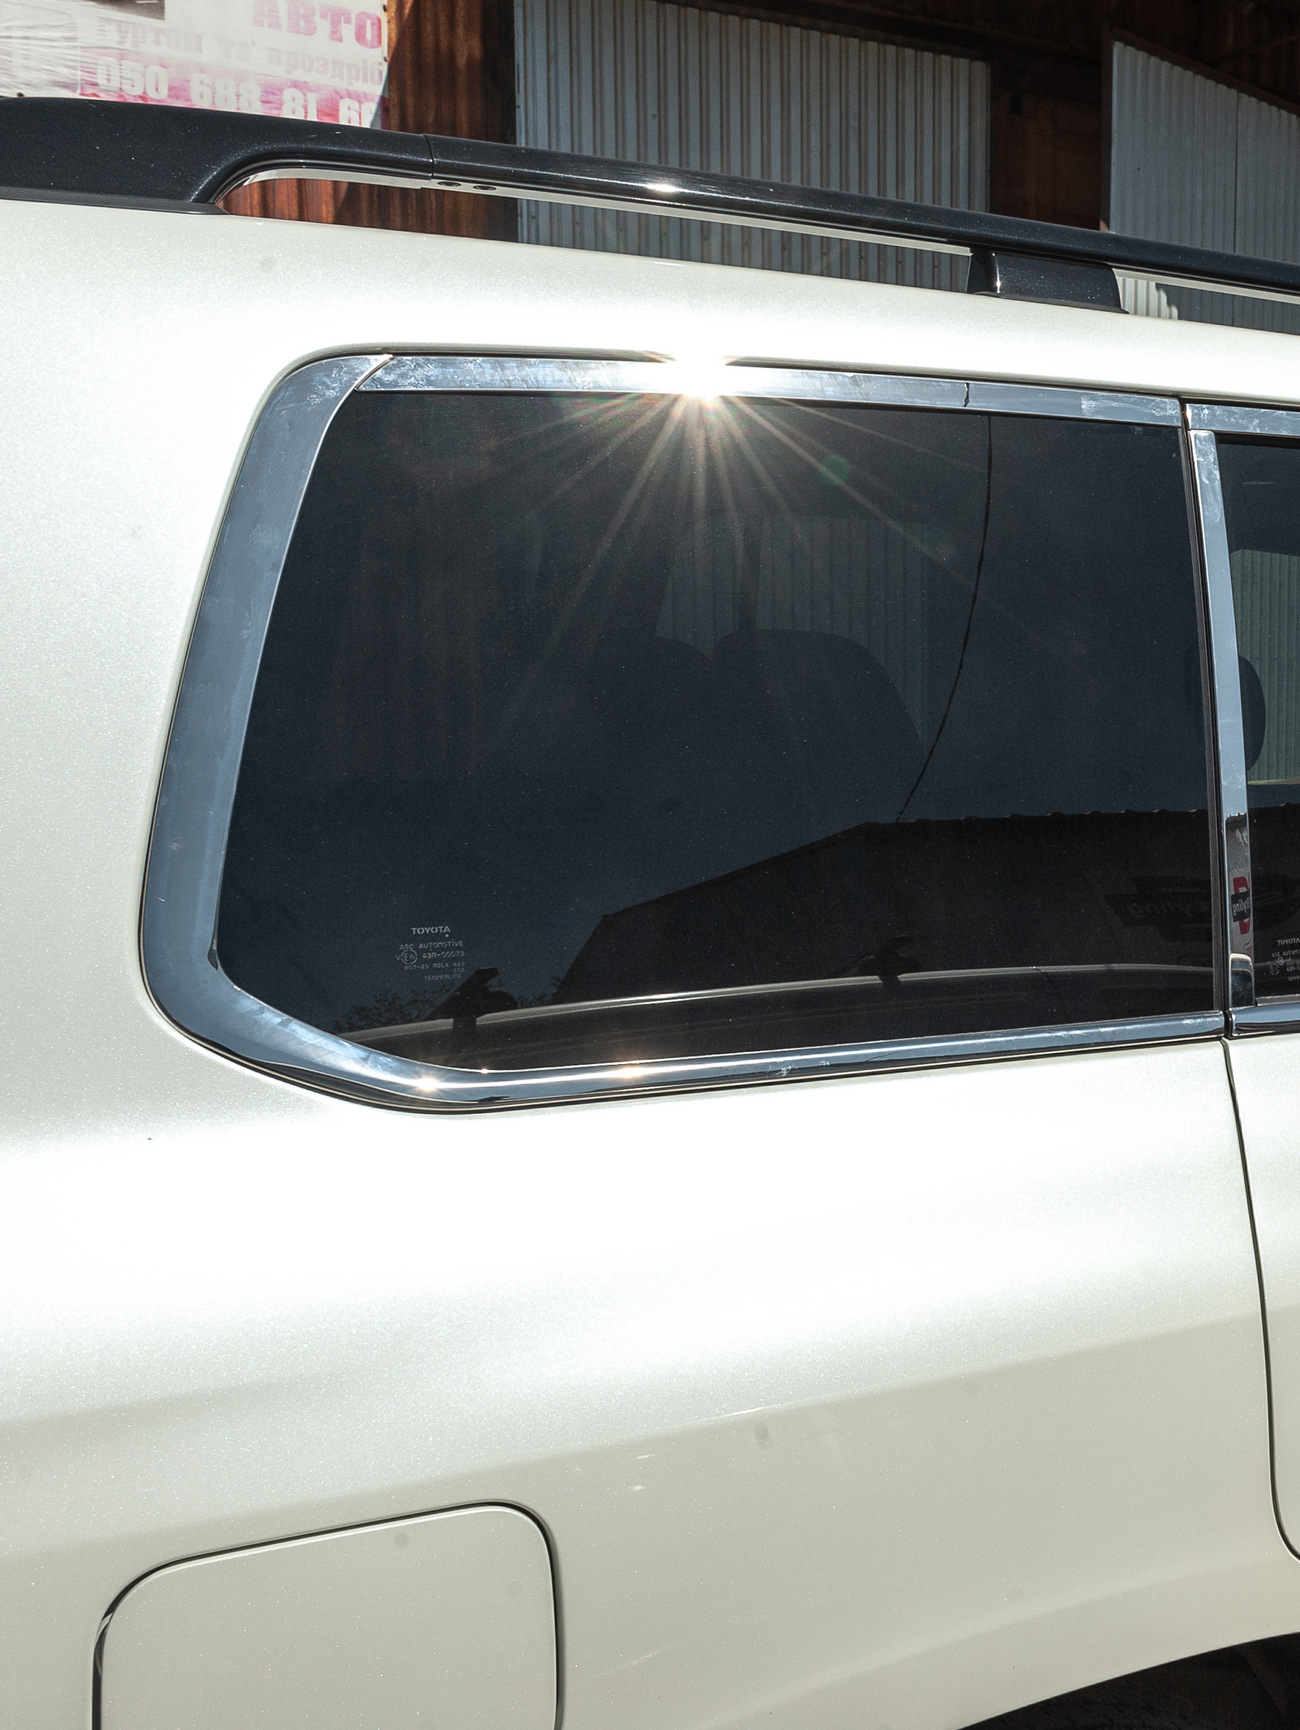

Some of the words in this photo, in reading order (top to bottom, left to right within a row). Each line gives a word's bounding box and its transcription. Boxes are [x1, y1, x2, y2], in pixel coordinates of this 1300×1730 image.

[254, 0, 382, 49] АВТО
[96, 57, 169, 99] 050
[190, 71, 262, 112] 688
[281, 87, 319, 122] 81
[411, 925, 452, 935] TOYOTA
[418, 939, 464, 950] AUTOMOTIVE
[1277, 937, 1300, 946] TOYOTA
